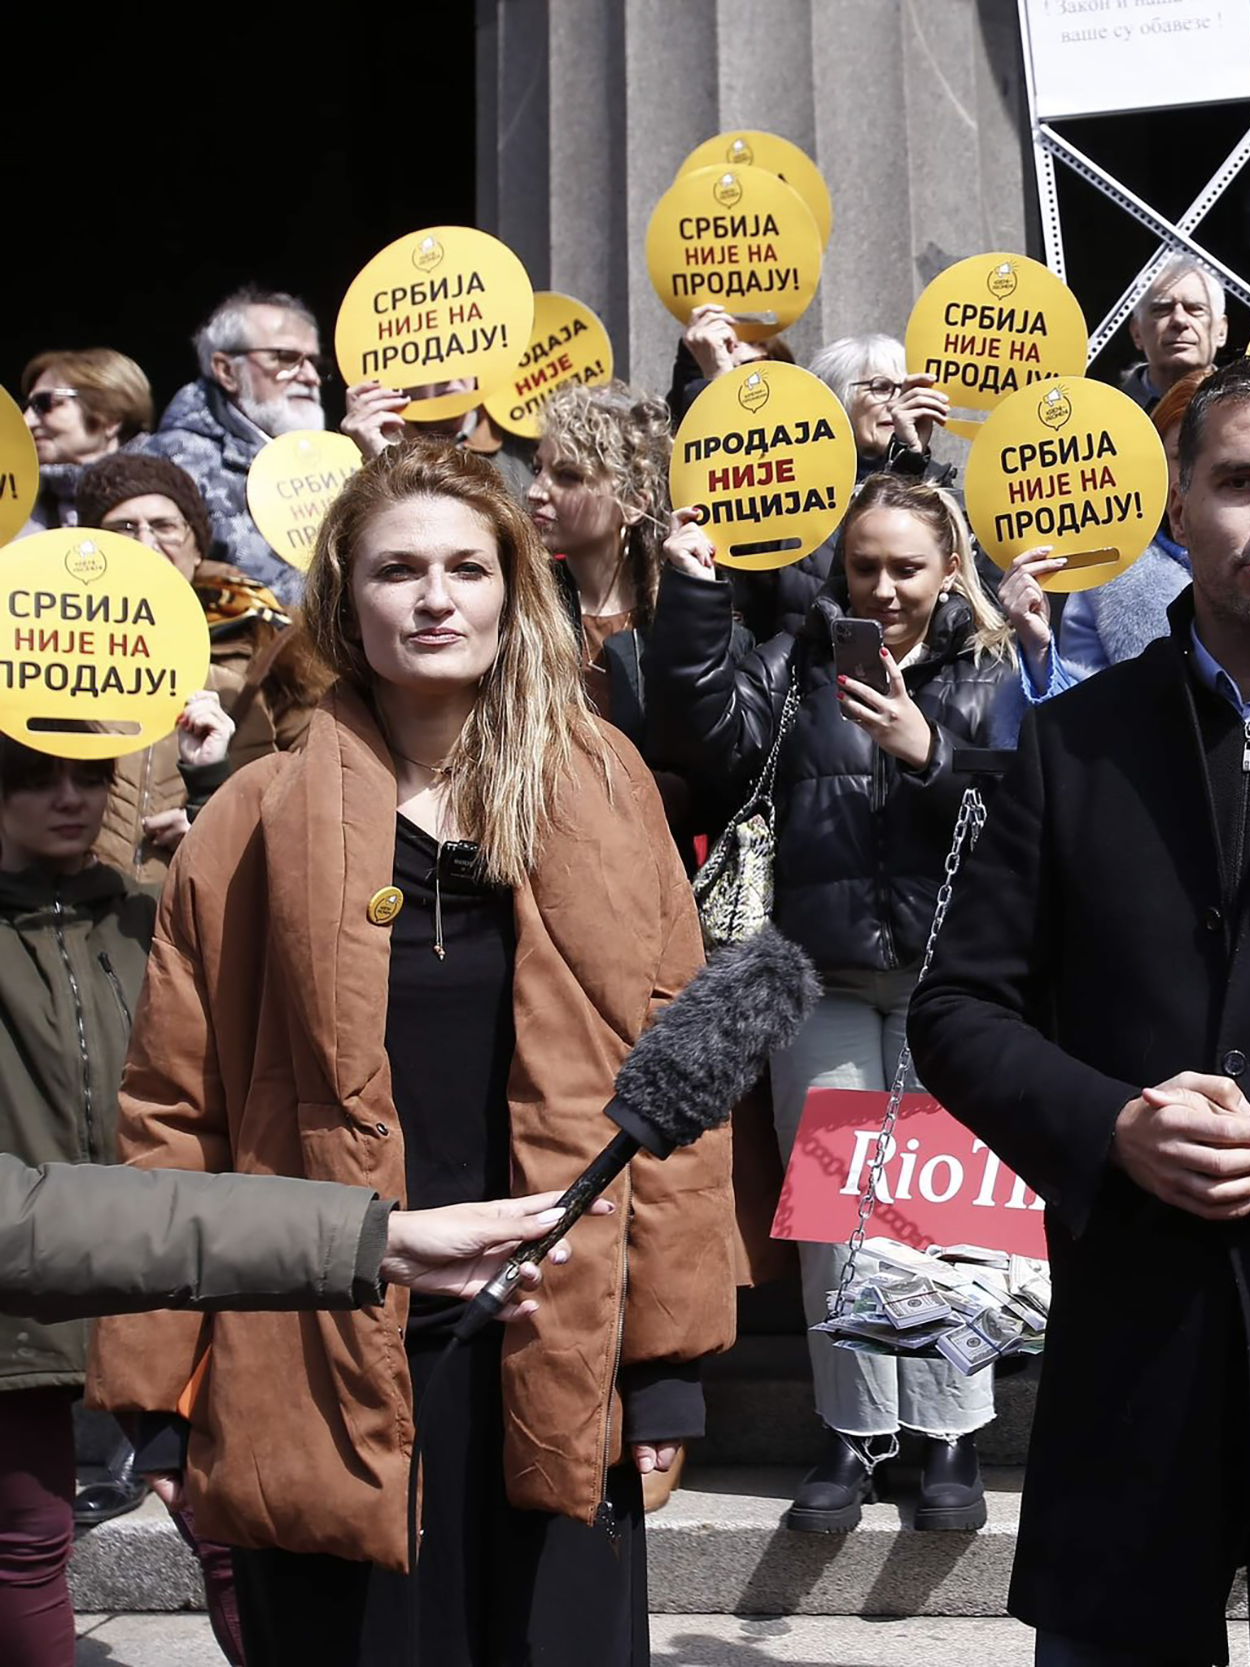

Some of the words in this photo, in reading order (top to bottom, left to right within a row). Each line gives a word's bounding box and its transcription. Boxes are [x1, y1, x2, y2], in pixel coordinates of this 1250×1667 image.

[1061, 27, 1108, 43] ваше
[1113, 24, 1133, 42] су
[1139, 16, 1211, 35] обавезе
[679, 214, 780, 240] СРБИЈА
[685, 245, 740, 266] НИЈЕ
[748, 243, 778, 263] НА
[373, 271, 486, 314] СРБИЈА
[671, 267, 800, 297] ПРОДАЈУ!
[378, 310, 438, 340] НИЈЕ
[449, 302, 483, 325] НА
[944, 302, 1047, 336] СРБИЈА
[362, 324, 508, 375] ПРОДАЈУ!
[943, 333, 1001, 358] НИЈЕ
[1009, 340, 1041, 363] НА
[514, 353, 573, 396] НИЈЕ
[684, 418, 836, 464] ПРОДАЈА
[1000, 430, 1118, 475] СРБИЈА
[708, 458, 796, 493] НИЈЕ
[1008, 472, 1072, 505] НИЈЕ
[1080, 465, 1117, 493] НА
[692, 486, 837, 527] ОПЦИЈА!
[994, 491, 1144, 543] ПРОДАЈУ!
[9, 590, 155, 625] СРБИЈА
[15, 628, 95, 655] НИЈЕ
[109, 633, 149, 658] НА
